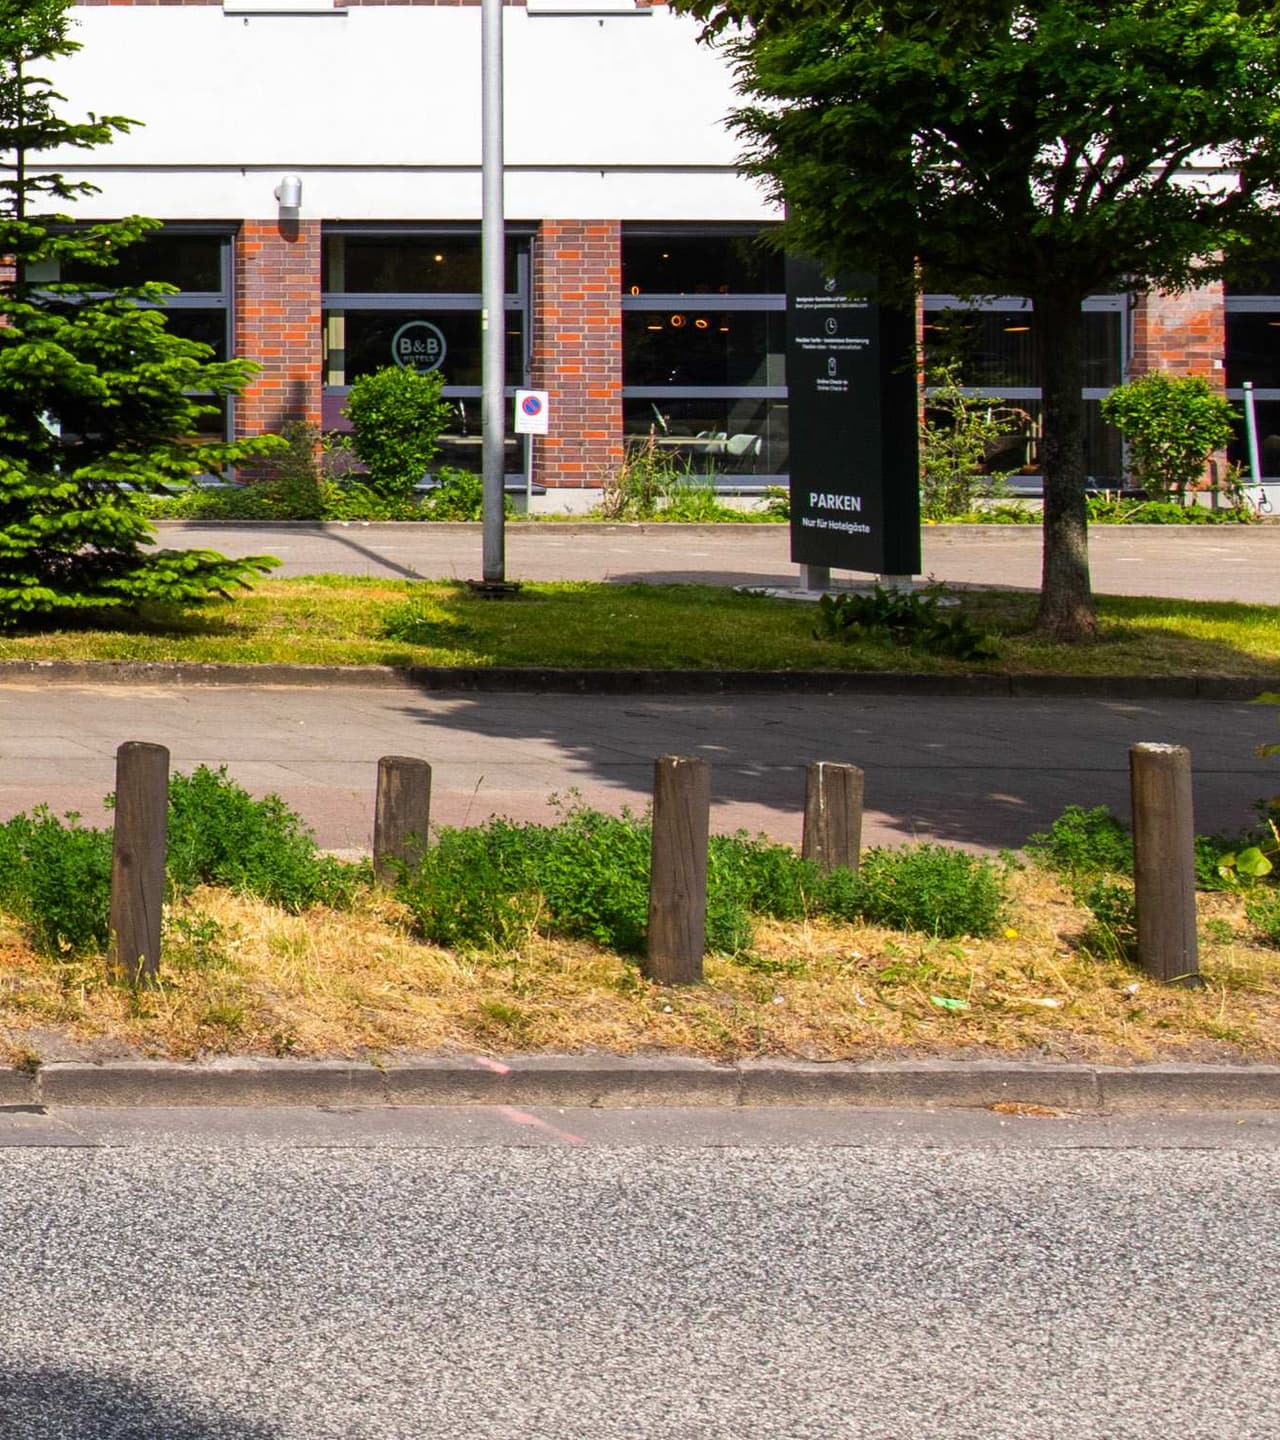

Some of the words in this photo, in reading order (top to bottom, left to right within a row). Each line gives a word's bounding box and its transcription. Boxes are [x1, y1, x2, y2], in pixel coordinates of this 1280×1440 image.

[400, 338, 439, 354] B&B
[809, 492, 861, 512] PARKEN
[802, 517, 816, 527] Nur
[828, 520, 871, 534] Hotelgäste
